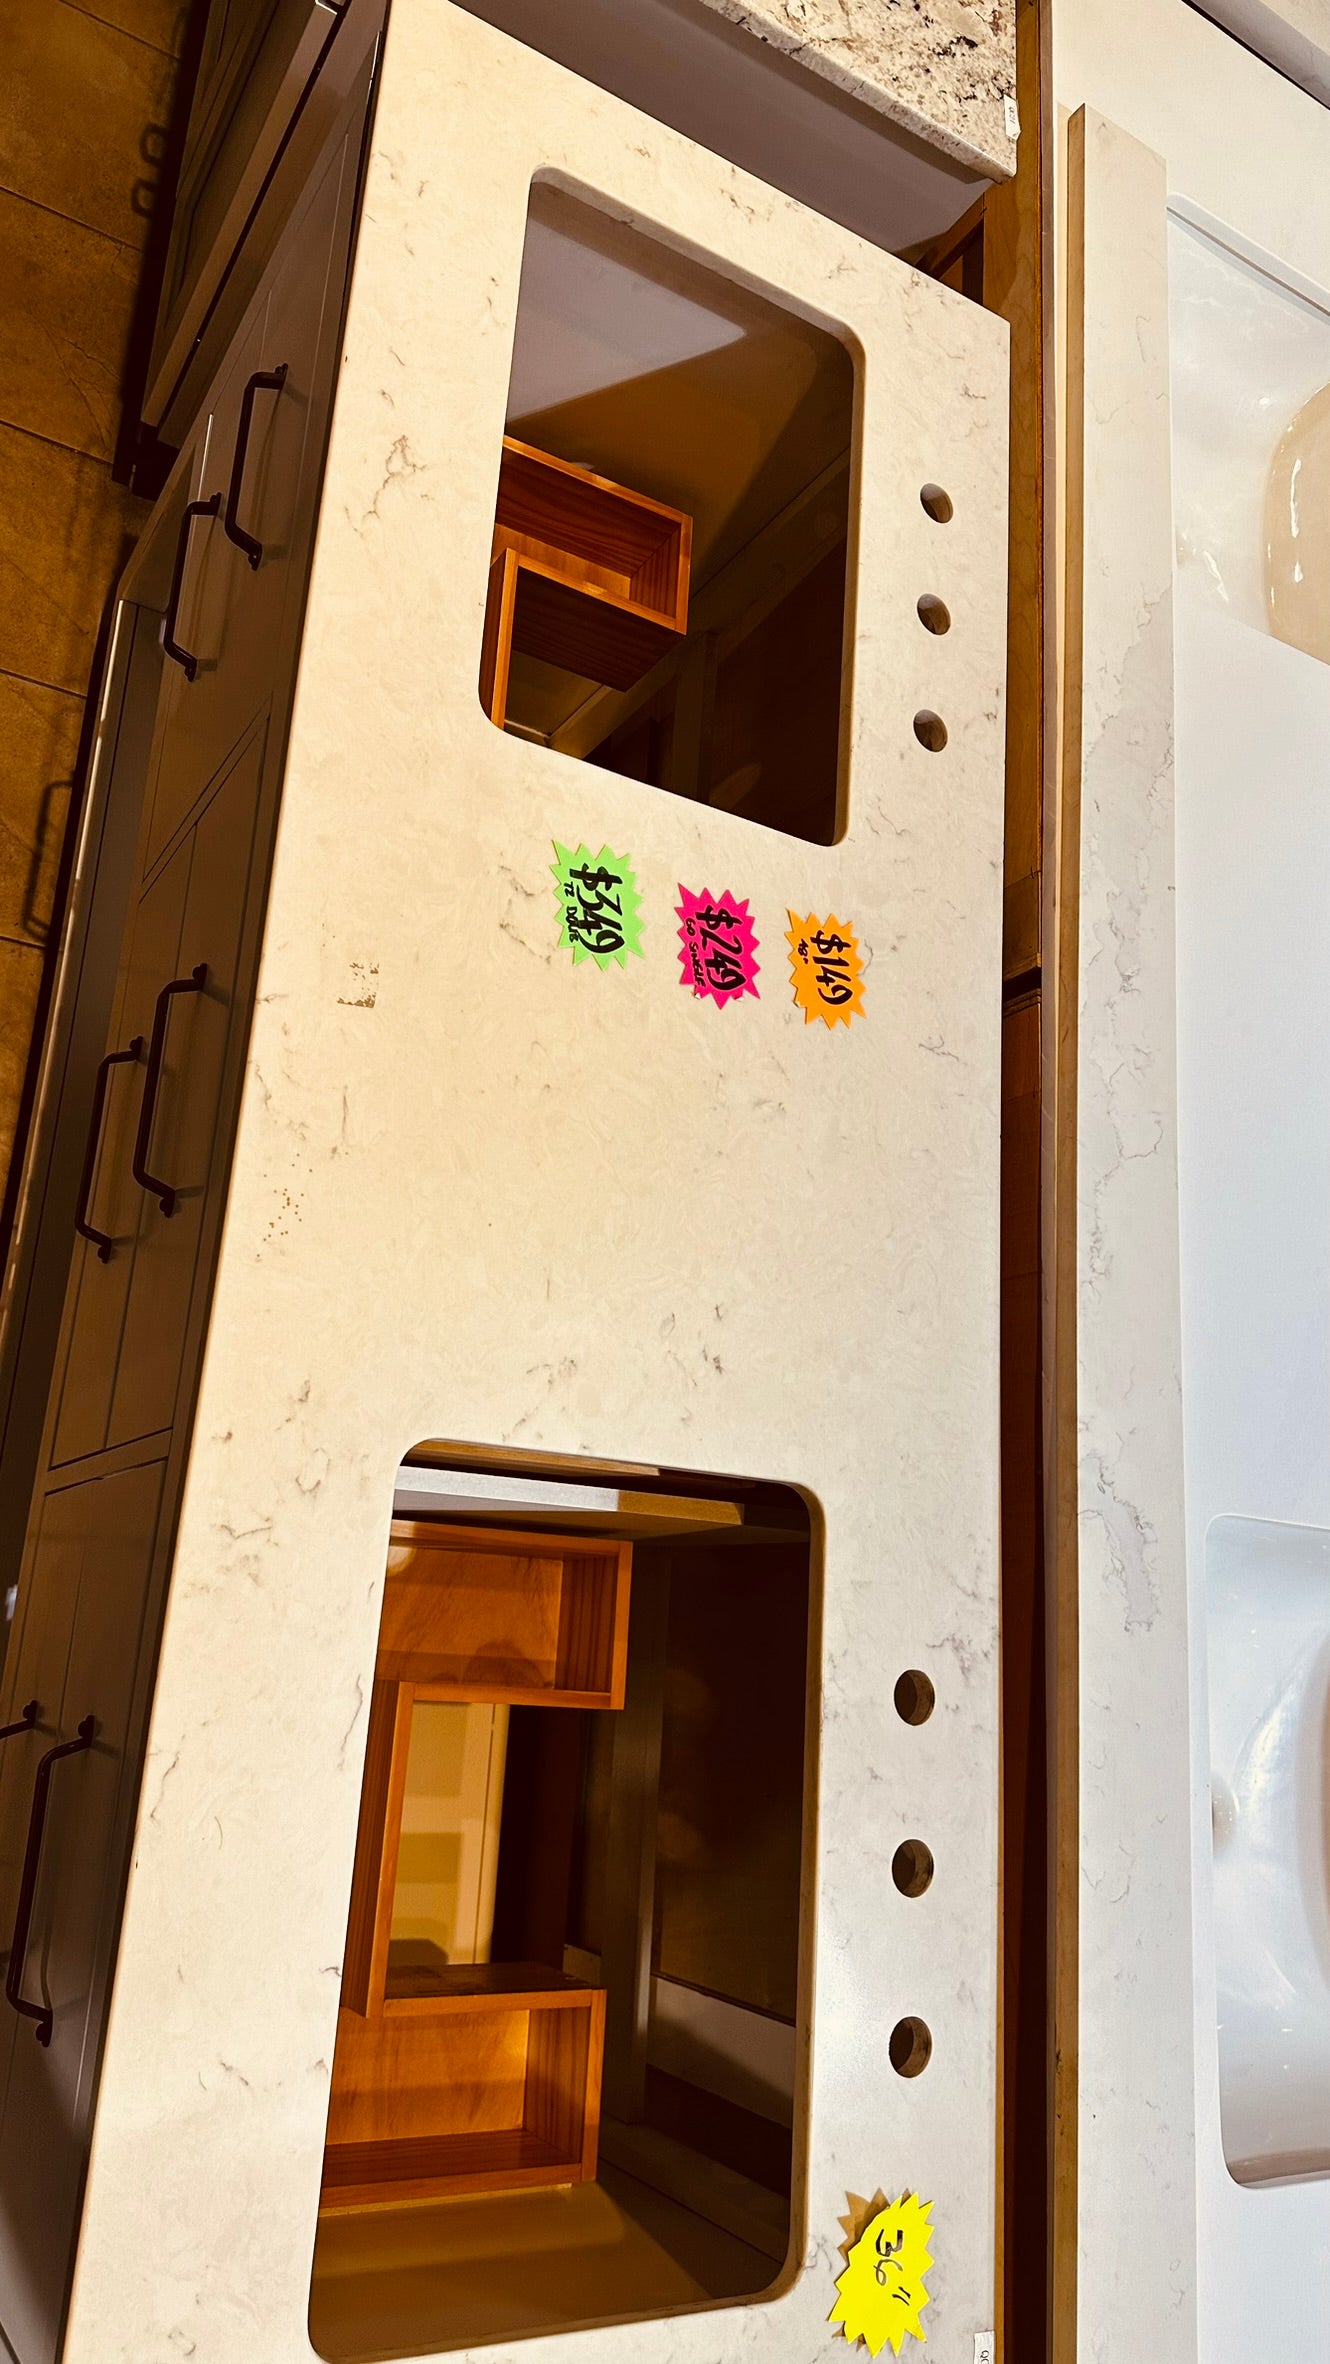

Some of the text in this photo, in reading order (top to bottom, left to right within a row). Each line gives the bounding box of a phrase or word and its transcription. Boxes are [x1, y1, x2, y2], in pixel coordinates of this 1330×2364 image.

[570, 863, 625, 953] $349
[695, 905, 746, 991] $249
[810, 930, 853, 1005] $149
[873, 2229, 911, 2306] 36"
